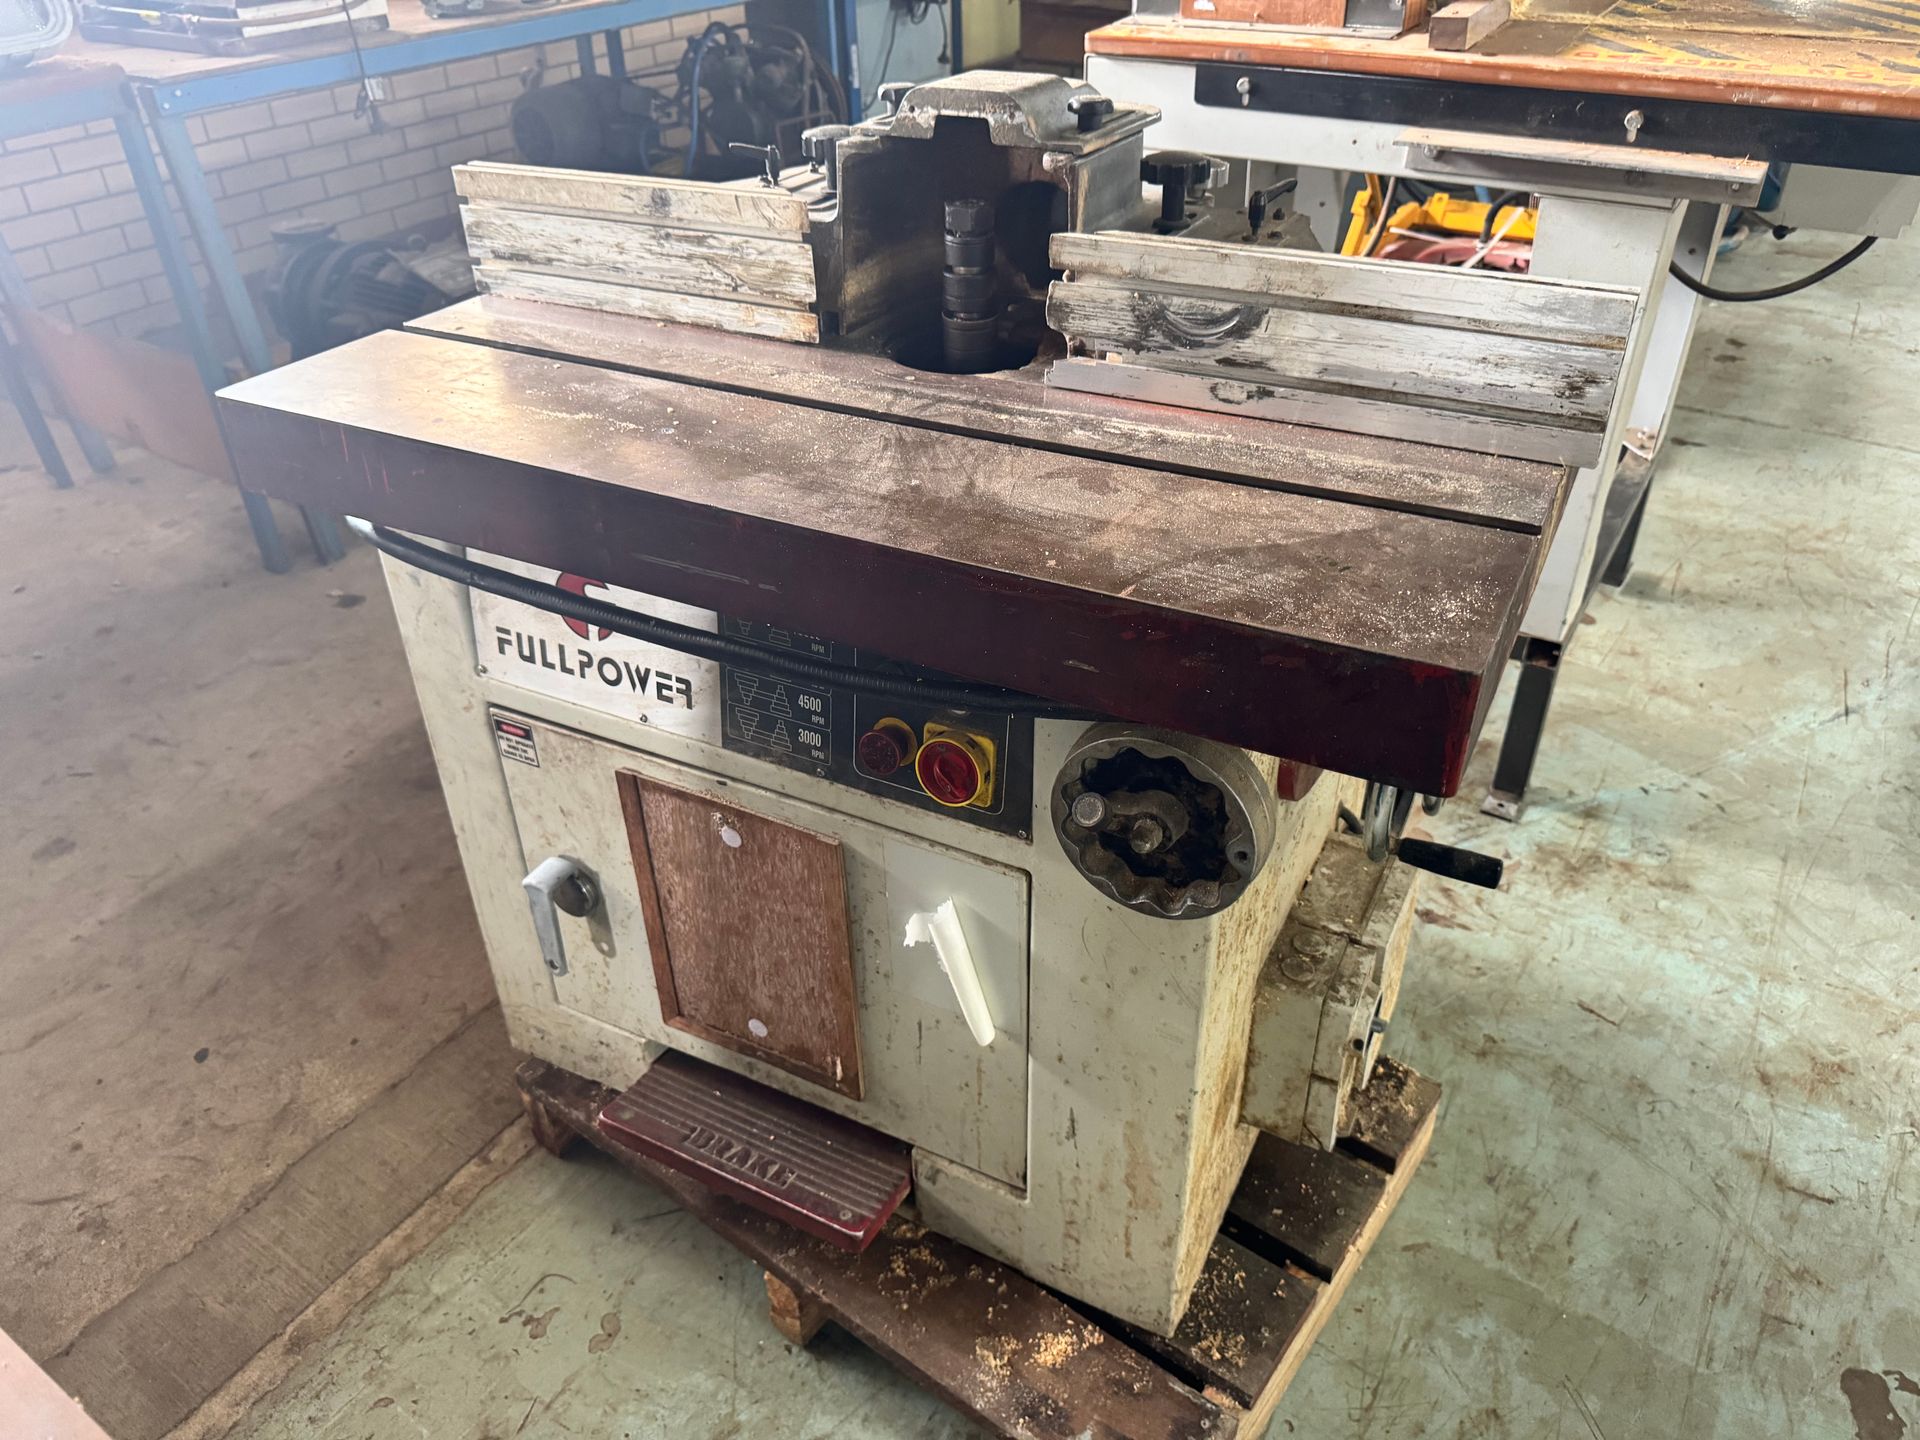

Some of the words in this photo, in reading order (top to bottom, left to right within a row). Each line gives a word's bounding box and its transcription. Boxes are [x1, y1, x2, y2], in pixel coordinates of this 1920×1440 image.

[811, 643, 825, 654] RPM
[496, 626, 693, 710] FULLPOWER
[797, 693, 822, 712] 4500
[811, 714, 825, 725] RPM
[798, 728, 822, 747] 3000
[811, 749, 825, 760] RPM
[682, 1126, 798, 1189] BRAKE
